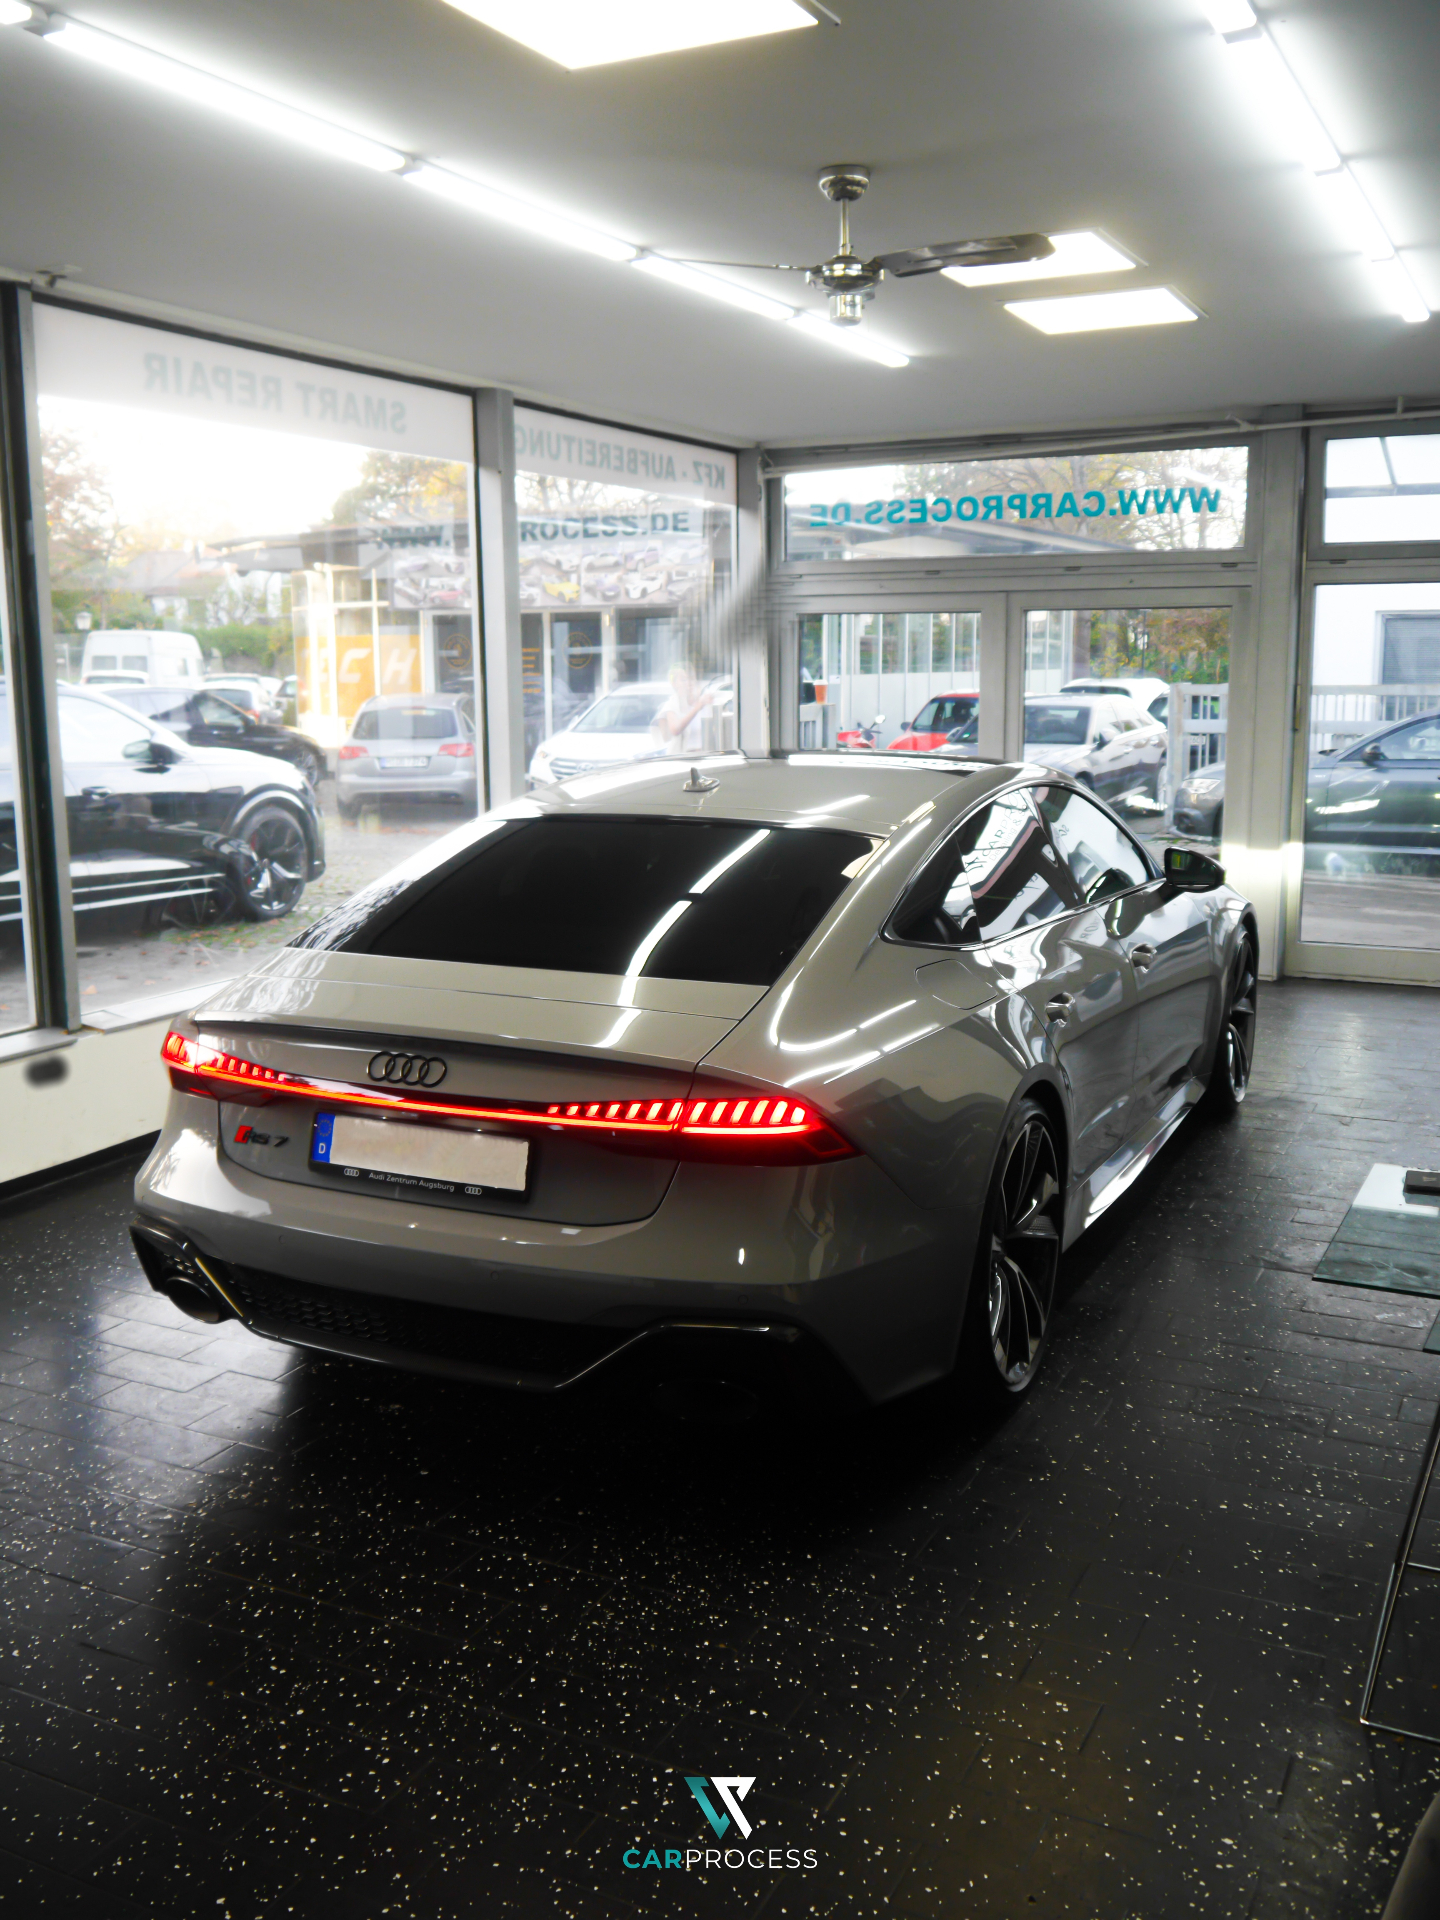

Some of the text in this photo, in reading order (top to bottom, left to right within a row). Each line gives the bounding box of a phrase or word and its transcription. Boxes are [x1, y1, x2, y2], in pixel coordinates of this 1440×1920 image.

[318, 1142, 326, 1154] D
[369, 1172, 455, 1193] Audi Zentrum Augsburg
